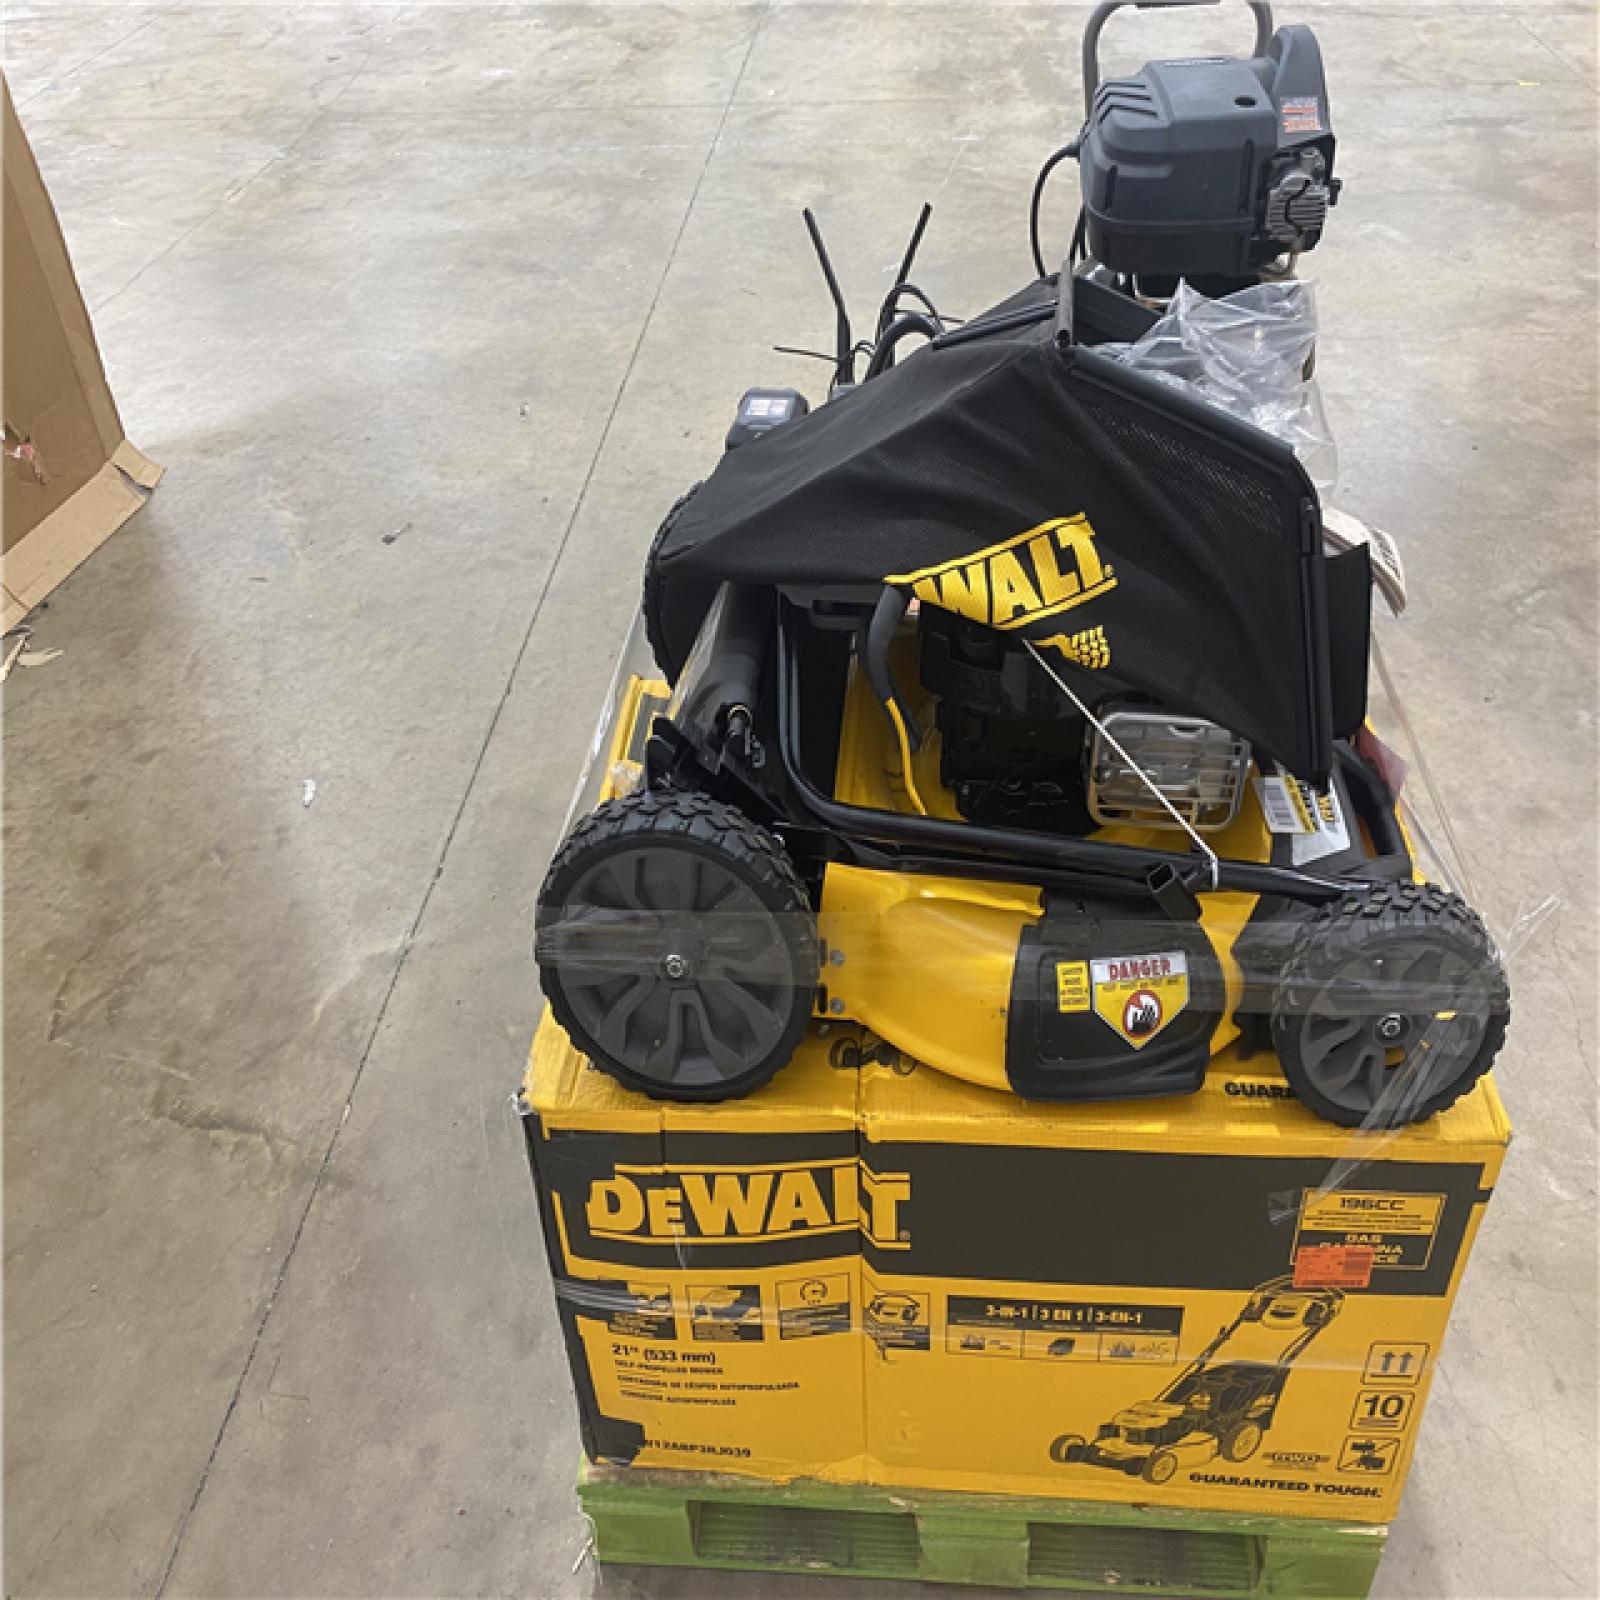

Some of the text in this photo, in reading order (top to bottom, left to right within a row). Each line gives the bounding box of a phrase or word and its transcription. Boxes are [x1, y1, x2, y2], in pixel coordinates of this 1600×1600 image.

[1108, 959, 1171, 981] DANGER
[1339, 1196, 1406, 1211] 196CC
[1344, 1233, 1383, 1244] GAS
[985, 1304, 1028, 1319] 3-IN-1
[1039, 1307, 1049, 1321] 3
[1095, 1311, 1143, 1324] 3-EN-1
[642, 1347, 677, 1363] (533
[680, 1351, 716, 1366] mm)
[1363, 1393, 1405, 1419] 10
[1188, 1471, 1309, 1492] GUARANTEED
